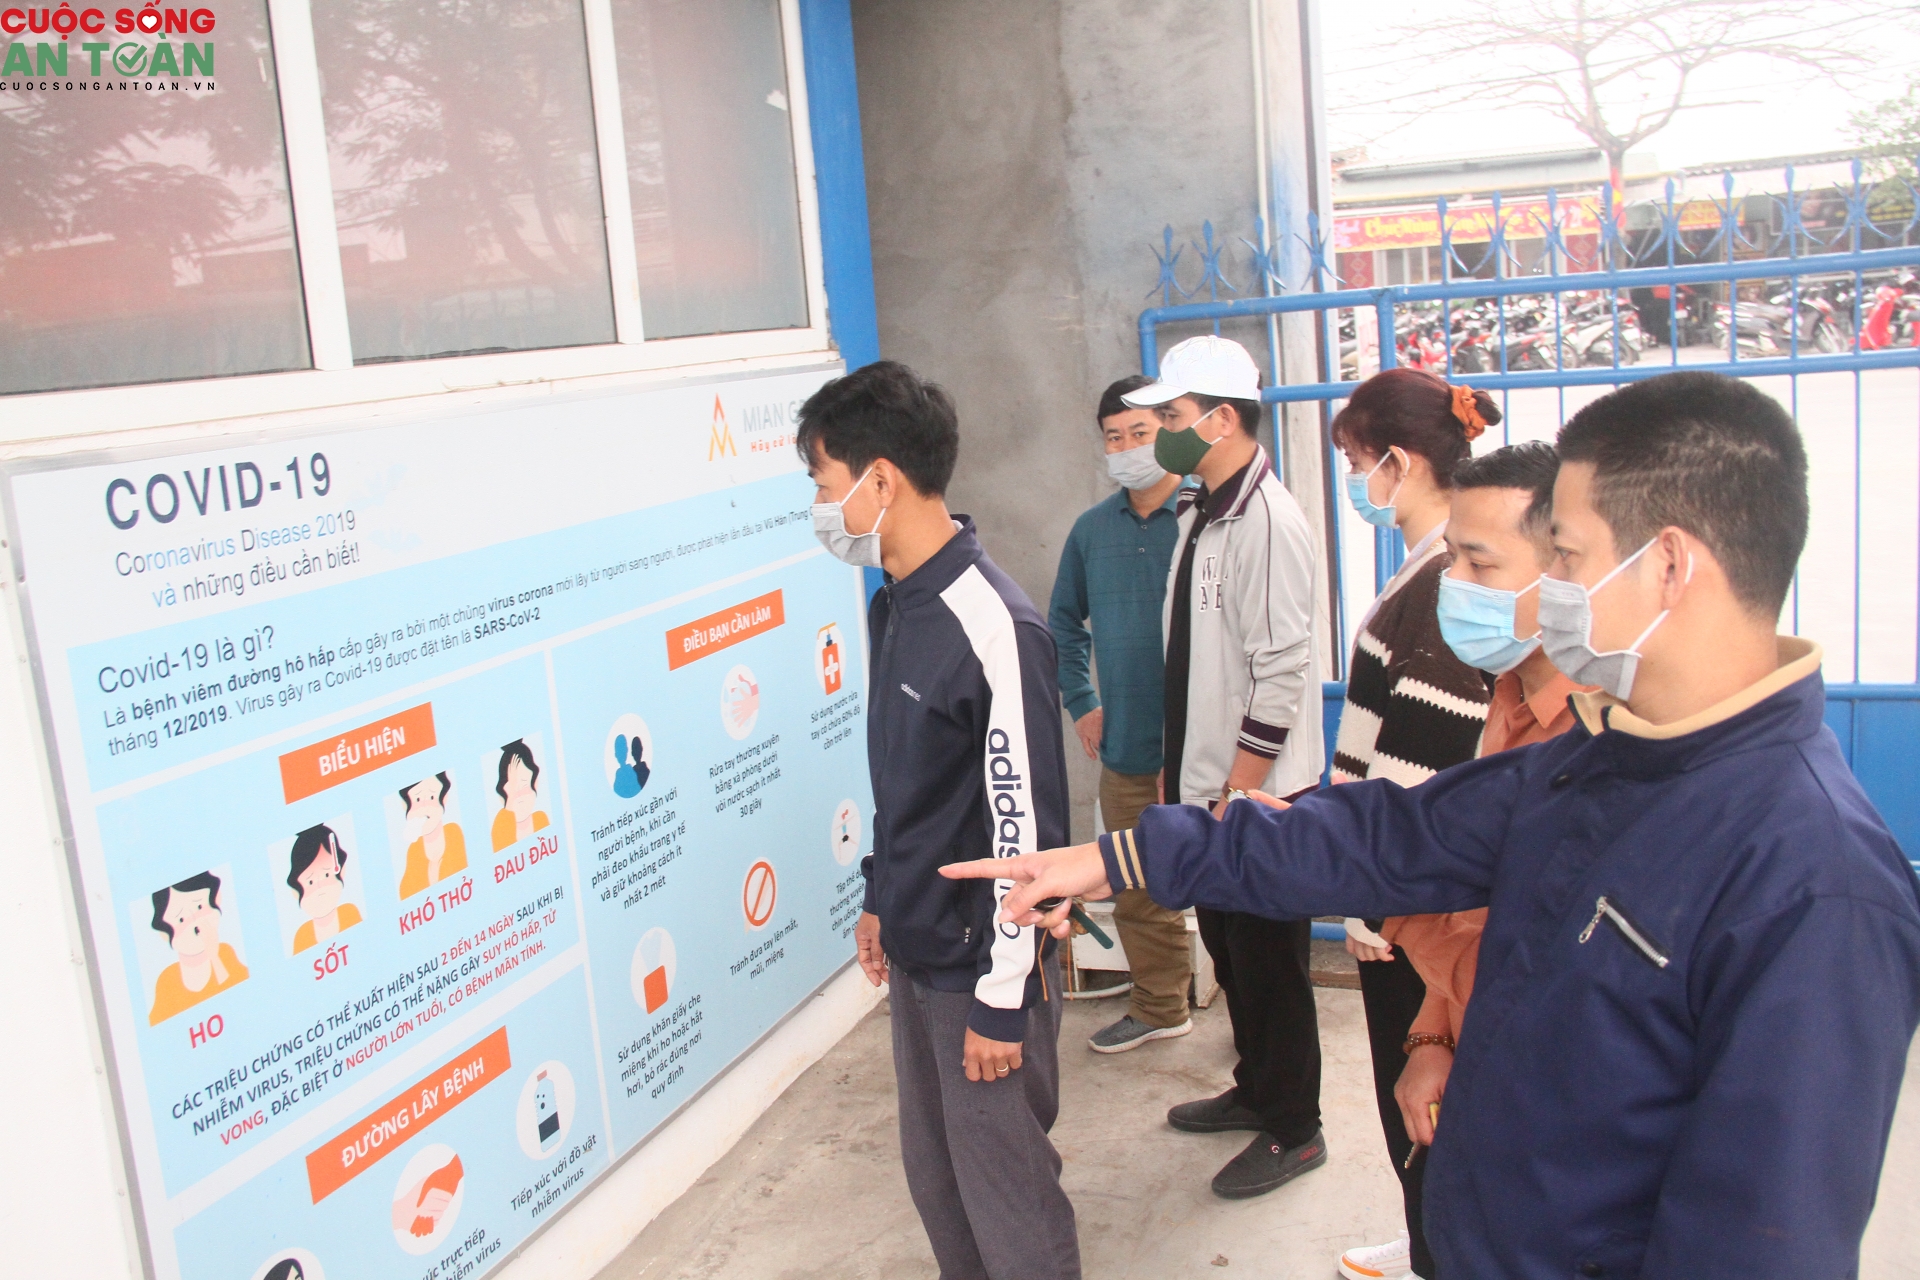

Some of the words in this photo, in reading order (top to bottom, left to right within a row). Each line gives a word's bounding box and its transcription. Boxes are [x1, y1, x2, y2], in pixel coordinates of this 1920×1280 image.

[742, 402, 784, 433] MIAN
[105, 452, 331, 530] COVID-19
[115, 537, 236, 577] Coronavirus
[241, 522, 311, 552] Disease
[316, 509, 356, 538] 2019
[152, 582, 177, 608] và
[183, 573, 245, 602] những
[250, 555, 287, 586] điều
[292, 549, 323, 575] cần
[327, 540, 360, 570] biết!
[104, 707, 127, 728] Là
[131, 693, 177, 721] bệnh
[182, 682, 223, 705] viêm
[227, 666, 282, 692] đường
[285, 655, 304, 675] hô
[308, 645, 335, 668] hấp
[339, 637, 362, 659] cấp
[365, 633, 388, 654] gây
[391, 629, 404, 642] ra
[406, 618, 426, 638] bởi
[429, 613, 451, 631] một
[452, 604, 486, 624] chủng
[487, 595, 515, 614] virus
[518, 584, 554, 604] corona
[556, 575, 574, 593] mới
[602, 560, 628, 580] người
[629, 556, 648, 570] sang
[683, 628, 708, 653] ĐIỀU
[709, 622, 730, 643] BẠN
[731, 612, 750, 634] CẦN
[751, 605, 771, 626] LÀM
[98, 643, 208, 693] Covid-19
[215, 636, 236, 663] là
[243, 625, 274, 661] gì?
[108, 729, 158, 756] tháng
[163, 704, 232, 738] 12/2019.
[235, 693, 275, 715] Virus
[278, 684, 303, 707] gây
[308, 679, 322, 695] ra
[325, 656, 382, 688] Covid-19
[386, 649, 418, 668] được
[420, 640, 439, 658] đặt
[441, 634, 459, 651] tên
[461, 629, 472, 645] là
[474, 606, 541, 640] SARS-CoV-2
[318, 739, 360, 777] BIỂU
[364, 726, 406, 759] HIỆN
[736, 744, 760, 764] thường
[591, 821, 615, 842] Tránh
[617, 811, 632, 829] tiếp
[634, 804, 648, 819] xúc
[650, 797, 663, 813] gần
[664, 787, 678, 802] với
[988, 728, 1025, 859] adidas
[494, 853, 525, 884] ĐAU
[529, 835, 558, 865] ĐẦU
[591, 866, 611, 889] phải
[612, 859, 628, 874] đeo
[629, 844, 649, 864] khẩu
[650, 834, 671, 852] trang
[598, 837, 624, 861] người
[625, 825, 648, 846] bệnh,
[649, 816, 662, 832] khi
[662, 810, 676, 825] cần
[600, 887, 611, 902] và
[613, 878, 626, 898] giữ
[627, 861, 657, 886] khoảng
[658, 849, 675, 868] cách
[624, 888, 643, 909] nhất
[650, 875, 666, 892] mét
[398, 896, 435, 935] KHÓ
[438, 876, 473, 913] THỞ
[313, 942, 350, 981] SỐT
[729, 955, 749, 976] Tránh
[749, 945, 763, 962] đưa
[765, 947, 785, 969] miệng
[172, 1092, 203, 1119] CÁC
[205, 1065, 248, 1102] TRIỆU
[251, 1035, 303, 1074] CHỨNG
[306, 1020, 324, 1043] CÓ
[327, 1001, 351, 1030] THỂ
[354, 986, 384, 1017] XUẤT
[387, 971, 415, 996] HIỆN
[417, 957, 439, 979] SAU
[441, 953, 448, 965] 2
[450, 936, 472, 962] ĐẾN
[474, 930, 486, 946] 14
[488, 913, 515, 937] NGÀY
[516, 903, 535, 922] SAU
[537, 891, 553, 910] KHI
[189, 1014, 224, 1049] HO
[192, 1095, 244, 1136] NHIỄM
[246, 1069, 293, 1103] VIRUS,
[294, 1043, 333, 1075] TRIỆU
[336, 1015, 382, 1051] CHỨNG
[384, 1002, 400, 1023] CÓ
[402, 983, 424, 1011] THỂ
[426, 969, 458, 997] NẶNG
[460, 955, 480, 976] GÂY
[483, 942, 501, 964] SUY
[504, 933, 519, 950] HÔ
[521, 919, 542, 942] HẤP,
[543, 908, 557, 927] TỬ
[617, 1046, 630, 1063] Sử
[631, 1032, 652, 1053] dụng
[651, 1016, 671, 1038] khăn
[672, 1002, 687, 1024] giấy
[688, 994, 701, 1009] che
[220, 1109, 269, 1145] VONG,
[271, 1089, 300, 1116] ĐẶC
[302, 1070, 329, 1097] BIỆT
[332, 1059, 343, 1078] Ở
[345, 1034, 388, 1071] NGƯỜI
[391, 1018, 414, 1044] LỚN
[415, 998, 447, 1026] TUỔI,
[448, 986, 463, 1007] CÓ
[465, 973, 493, 998] BỆNH
[495, 954, 519, 978] MÃN
[520, 940, 547, 962] TÍNH.
[621, 1057, 646, 1082] miệng
[646, 1043, 660, 1062] khi
[660, 1037, 671, 1051] ho
[671, 1022, 690, 1042] hoặc
[690, 1009, 703, 1027] hắt
[626, 1078, 644, 1098] hơi,
[645, 1066, 655, 1084] bỏ
[656, 1059, 668, 1075] rác
[669, 1042, 689, 1064] đúng
[689, 1029, 702, 1048] nơi
[651, 1080, 666, 1099] quy
[667, 1064, 684, 1085] định
[341, 1108, 410, 1168] ĐƯỜNG
[413, 1088, 439, 1121] LÂY
[443, 1057, 485, 1097] BỆNH
[510, 1187, 533, 1211] Tiếp
[534, 1173, 551, 1193] xúc
[552, 1157, 567, 1178] với
[569, 1145, 581, 1164] đồ
[531, 1187, 561, 1218] nhiễm
[562, 1167, 584, 1191] virus
[441, 1247, 463, 1271] trực
[464, 1228, 485, 1251] tiếp
[475, 1238, 501, 1264] virus
